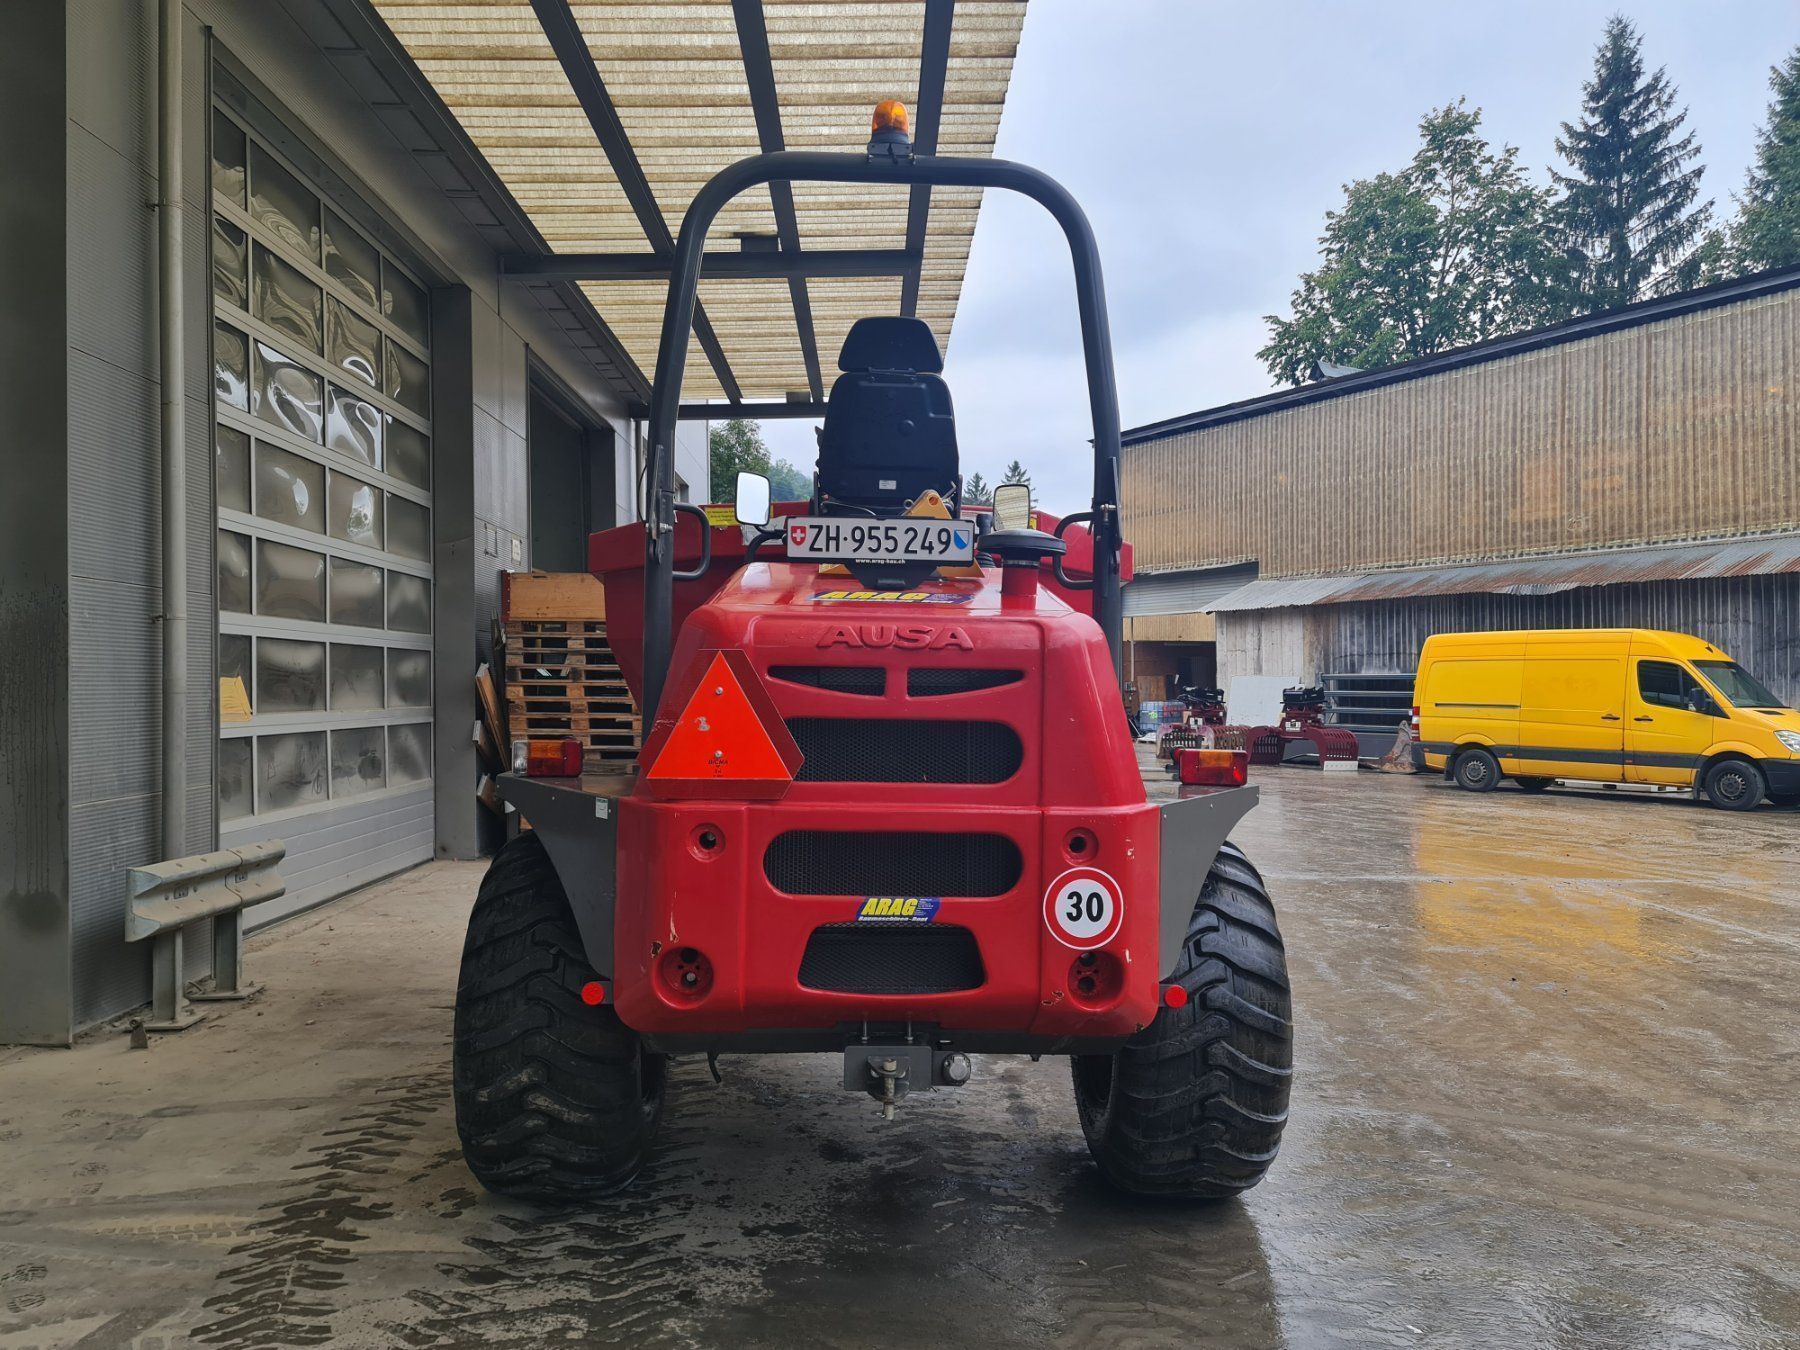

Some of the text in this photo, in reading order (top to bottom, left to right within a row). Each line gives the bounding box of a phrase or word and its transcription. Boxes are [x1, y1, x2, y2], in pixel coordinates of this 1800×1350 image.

[816, 625, 974, 650] AUSA
[860, 898, 919, 916] ARAG
[1066, 891, 1104, 923] 30
